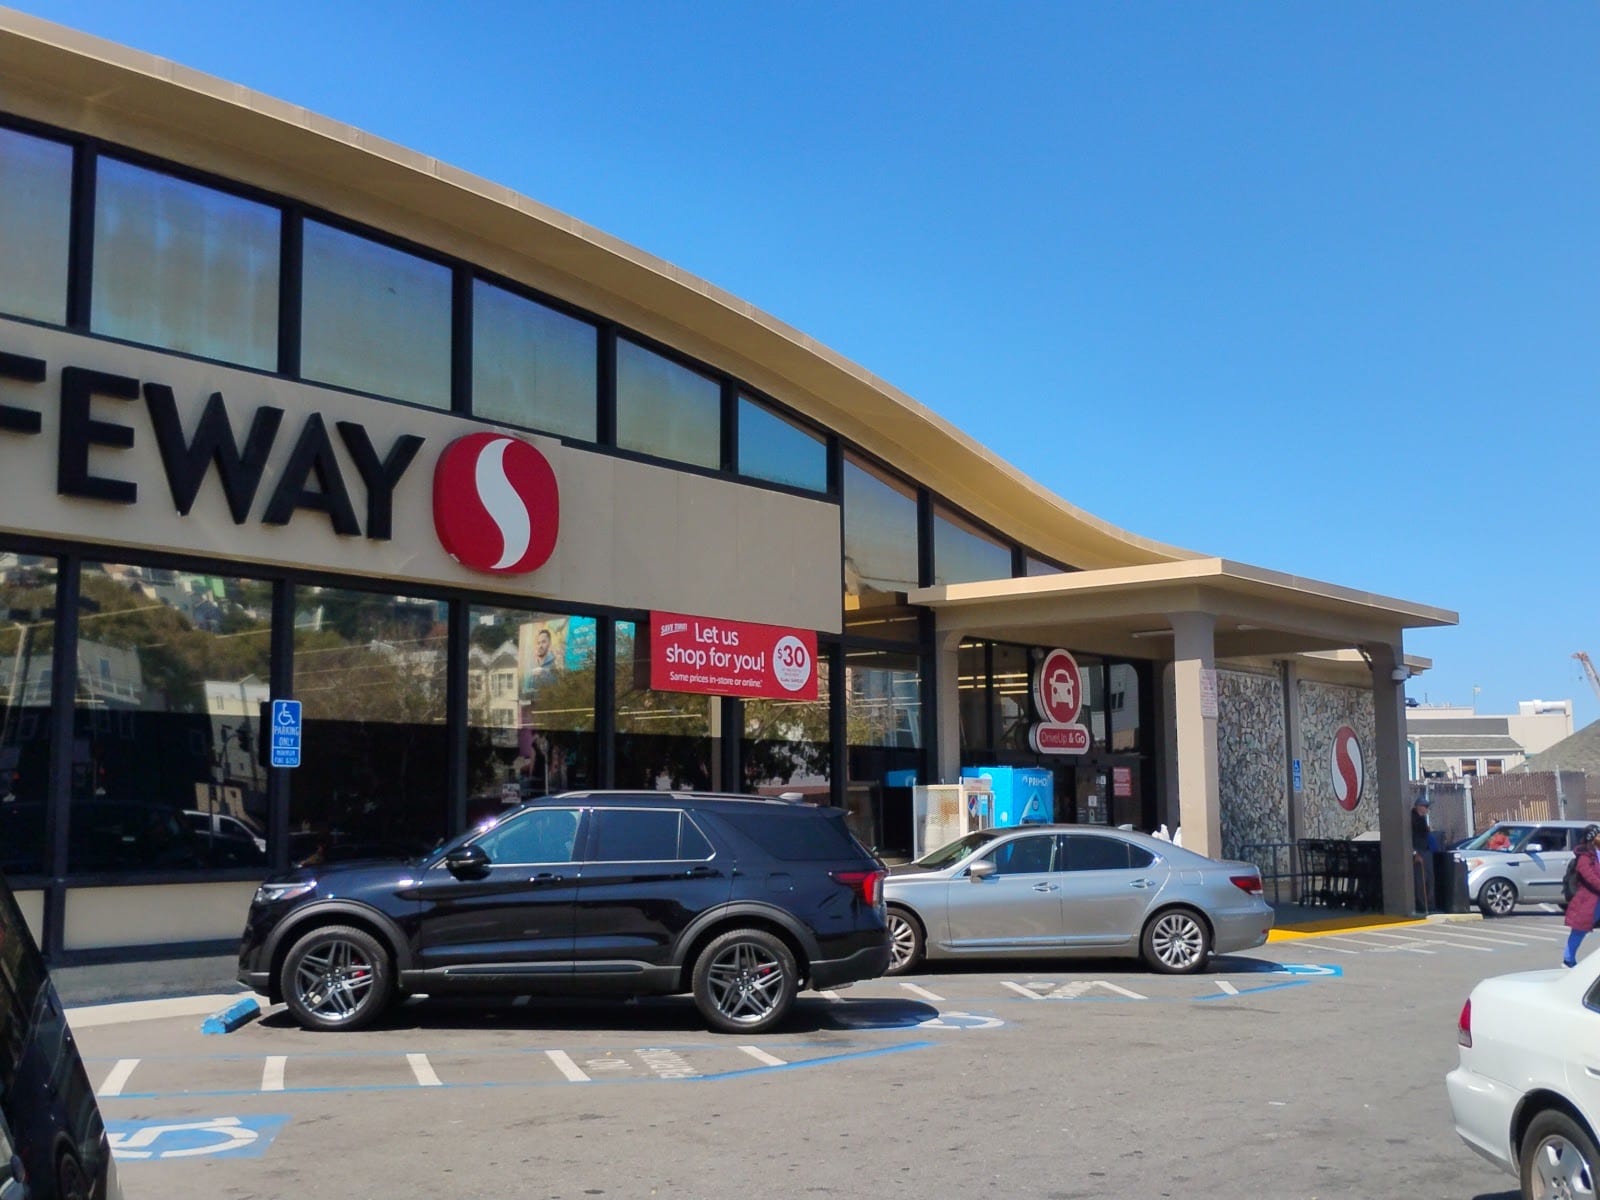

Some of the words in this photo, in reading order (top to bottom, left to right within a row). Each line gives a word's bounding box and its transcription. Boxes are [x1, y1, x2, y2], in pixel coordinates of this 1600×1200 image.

[695, 622, 718, 643] Let
[722, 630, 739, 646] us
[666, 643, 706, 670] shop
[709, 647, 731, 667] for
[733, 651, 765, 673] you!
[777, 644, 805, 668] $30
[669, 671, 689, 683] Same
[689, 673, 709, 684] prices
[709, 674, 734, 686] in-store
[734, 677, 741, 686] or
[274, 726, 300, 736] PARKING
[1068, 733, 1074, 743] &
[1075, 733, 1085, 744] Go
[279, 737, 294, 746] ONLY
